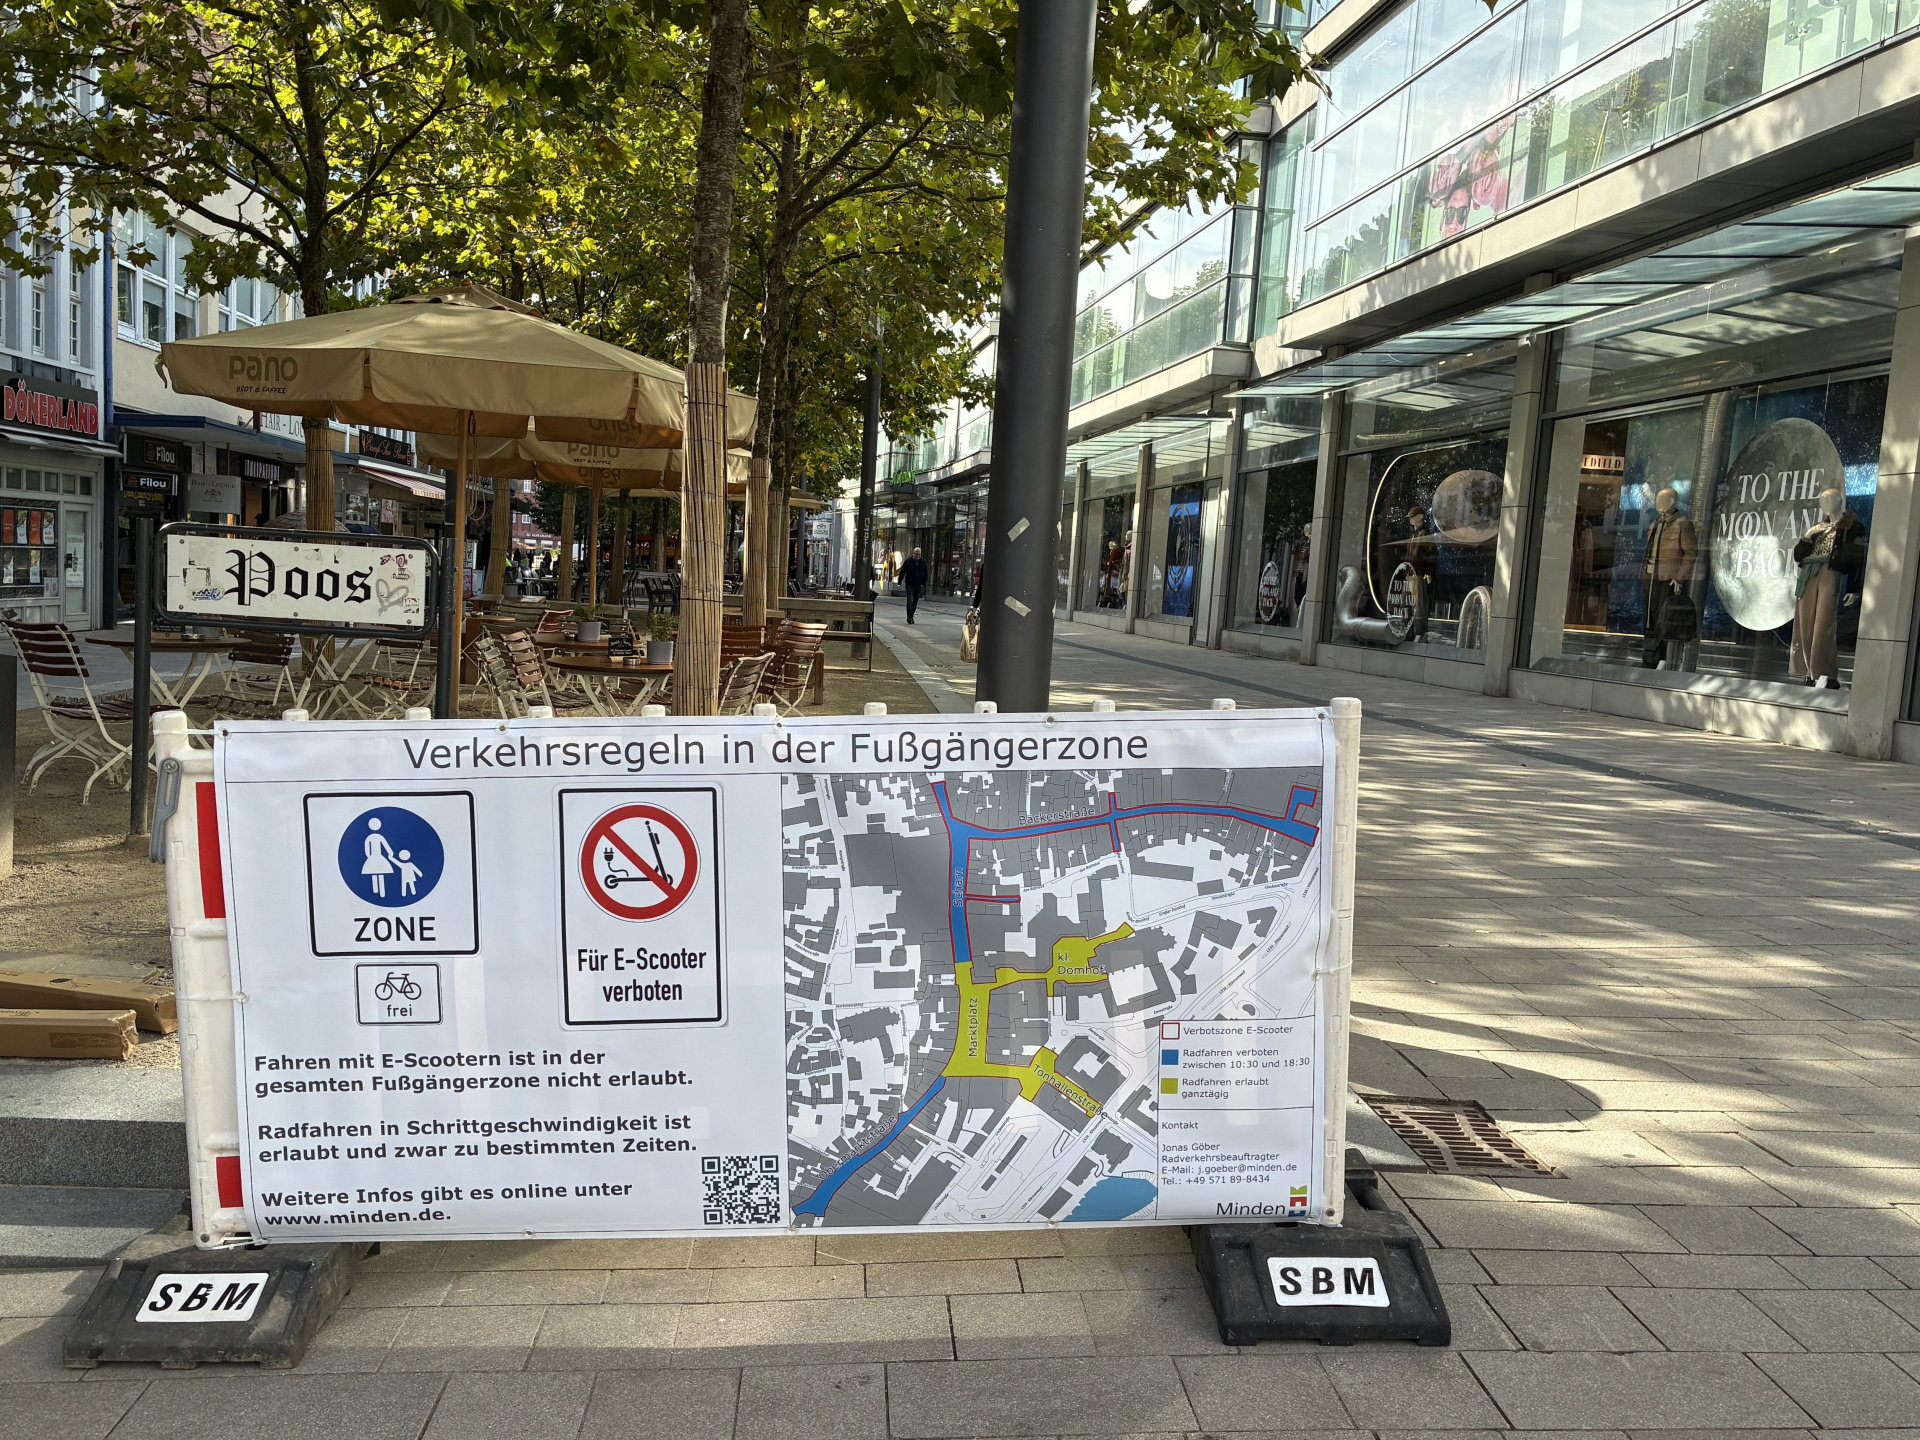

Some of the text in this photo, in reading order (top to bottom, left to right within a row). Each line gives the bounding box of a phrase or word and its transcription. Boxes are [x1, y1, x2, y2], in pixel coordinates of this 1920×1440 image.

[4, 378, 98, 435] DÖNERLAND
[156, 446, 175, 464] Filou
[140, 477, 167, 488] Filou
[1738, 468, 1825, 504] TO THE
[1717, 510, 1777, 543] MOON
[225, 548, 374, 607] Poos
[403, 731, 1148, 773] Verkehrsregeln in der Fußgängerzone
[1019, 807, 1095, 825] Bäckerstraße
[952, 867, 964, 907] Scharn
[354, 916, 436, 942] ZONE
[577, 946, 707, 972] Für E-Scooter
[1058, 952, 1071, 962] kl.
[1058, 966, 1105, 975] Domhof
[602, 979, 683, 1003] verboten
[386, 1004, 413, 1017] frei
[968, 997, 979, 1057] Marktplatz
[1183, 1025, 1293, 1035] Verbotszone E-Scooter
[254, 1049, 606, 1071] Fahren mit E-Scootern ist in der
[1182, 1057, 1310, 1069] zwischen 10:30 und 18:30
[1183, 1048, 1279, 1057] Radfahren verboten
[255, 1070, 693, 1098] gesamten Fußgängerzone nicht erlaubt.
[1033, 1064, 1108, 1120] Tonhallenstraße
[1182, 1077, 1269, 1086] Radfahren erlaubt
[1181, 1090, 1229, 1099] ganztägig
[258, 1114, 692, 1140] Radfahren in Schrittgeschwindigkeit ist
[1161, 1121, 1199, 1130] Kontakt
[258, 1138, 697, 1163] erlaubt und zwar zu bestimmten Zeiten.
[819, 1115, 897, 1180] Obermarktstraße
[1161, 1142, 1220, 1152] Jonas Göber
[1161, 1152, 1280, 1163] Radverkehrsbeauftragter
[1161, 1163, 1298, 1175] E-Mail: j.goeber@minden.de
[1161, 1174, 1270, 1185] Tel.: +49 571 89-8434
[261, 1182, 633, 1207] Weitere Infos gibt es online unter
[264, 1208, 452, 1226] www.minden.de.
[1216, 1202, 1286, 1216] Minden
[1279, 1266, 1375, 1296] SBM
[148, 1282, 260, 1312] SBM
